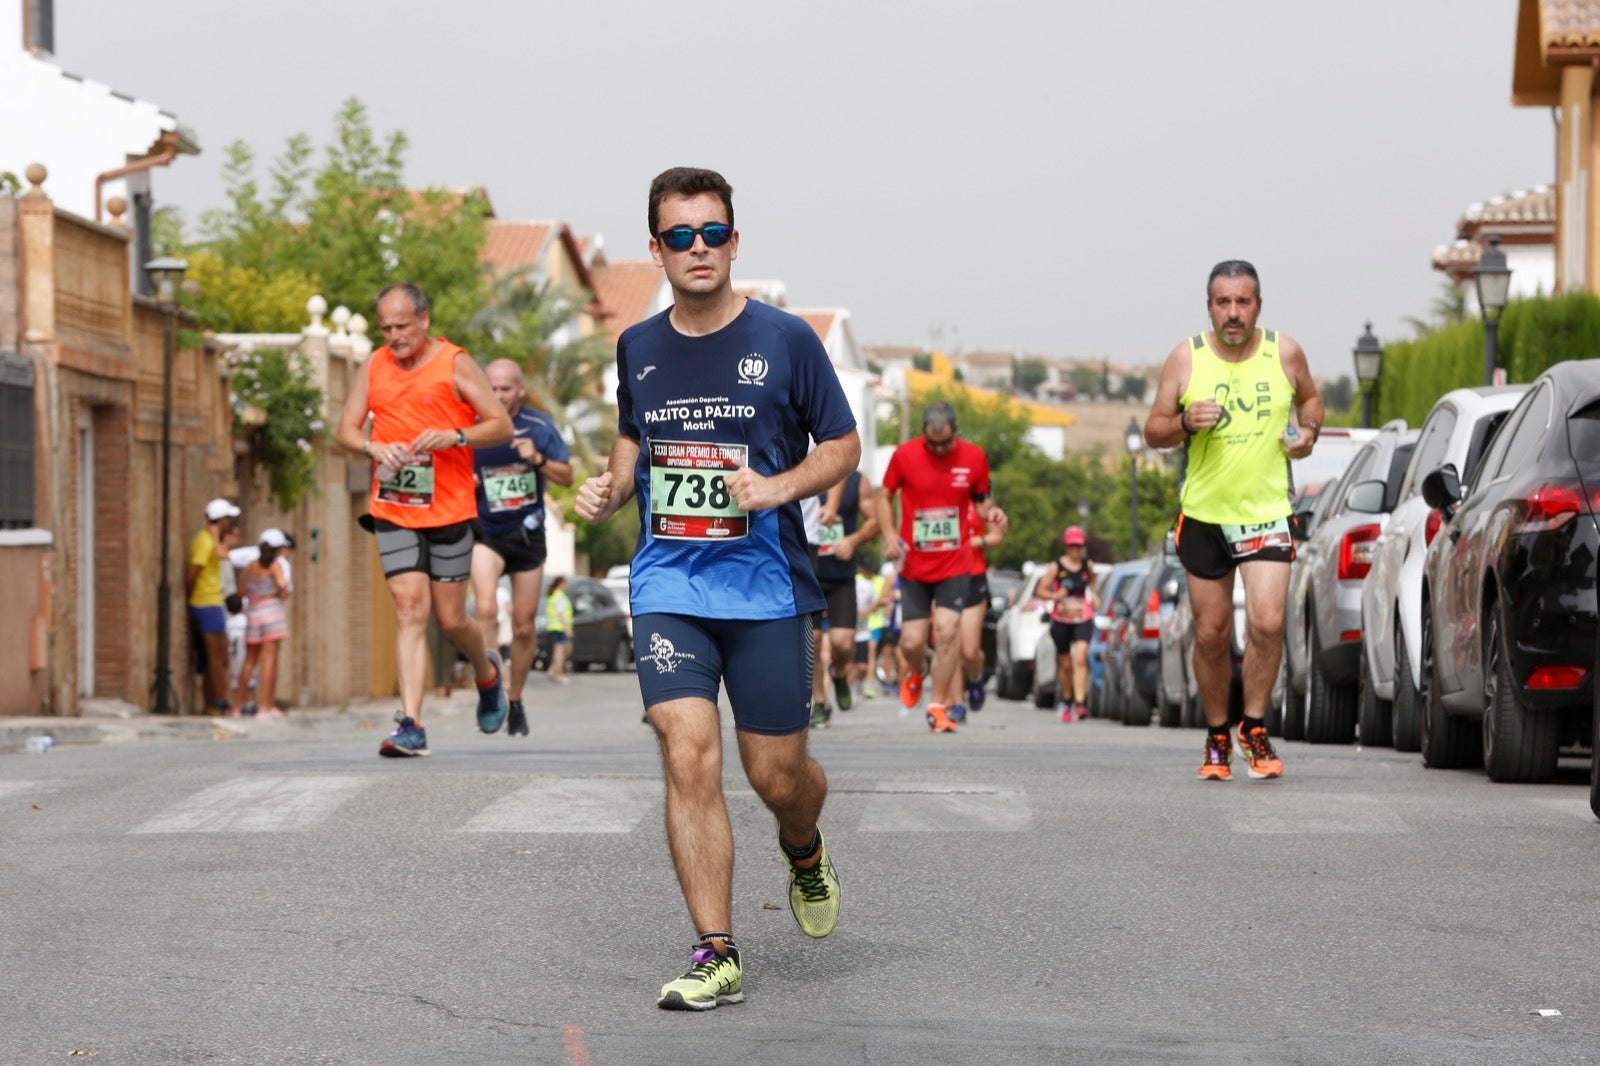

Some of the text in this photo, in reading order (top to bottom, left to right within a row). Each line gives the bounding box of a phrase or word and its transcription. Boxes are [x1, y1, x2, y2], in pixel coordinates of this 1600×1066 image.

[744, 359, 762, 373] 30
[666, 396, 729, 406] Asociación Deportiva
[645, 405, 756, 424] PAZITO a PAZITO
[683, 420, 715, 431] Motril
[668, 445, 685, 457] GRAN
[686, 446, 710, 458] PREMIO
[711, 447, 718, 459] DE
[719, 447, 741, 460] FONDO
[695, 459, 724, 469] CRUZCAMPO
[495, 476, 529, 496] 746
[664, 473, 731, 510] 738
[922, 521, 952, 537] 748
